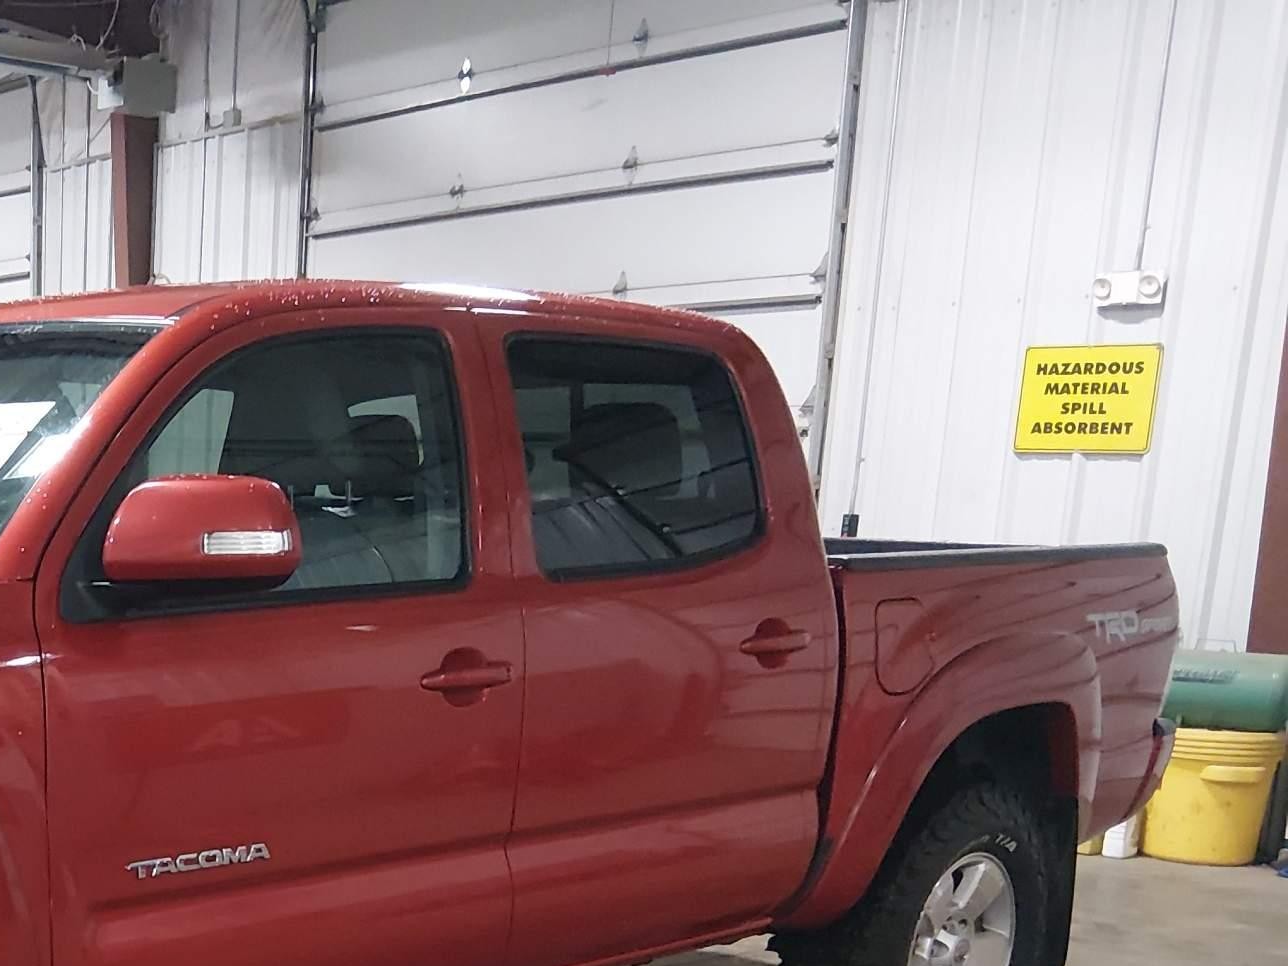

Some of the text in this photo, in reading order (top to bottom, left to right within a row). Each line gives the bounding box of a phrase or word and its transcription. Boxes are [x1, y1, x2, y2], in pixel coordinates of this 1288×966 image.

[1036, 361, 1145, 375] HAZARDOUS
[1044, 382, 1129, 395] MATERIAL
[1060, 402, 1107, 415] SPILL
[1031, 422, 1133, 435] ABSORBENT
[1086, 610, 1138, 643] TRD
[125, 843, 271, 880] TACOMA
